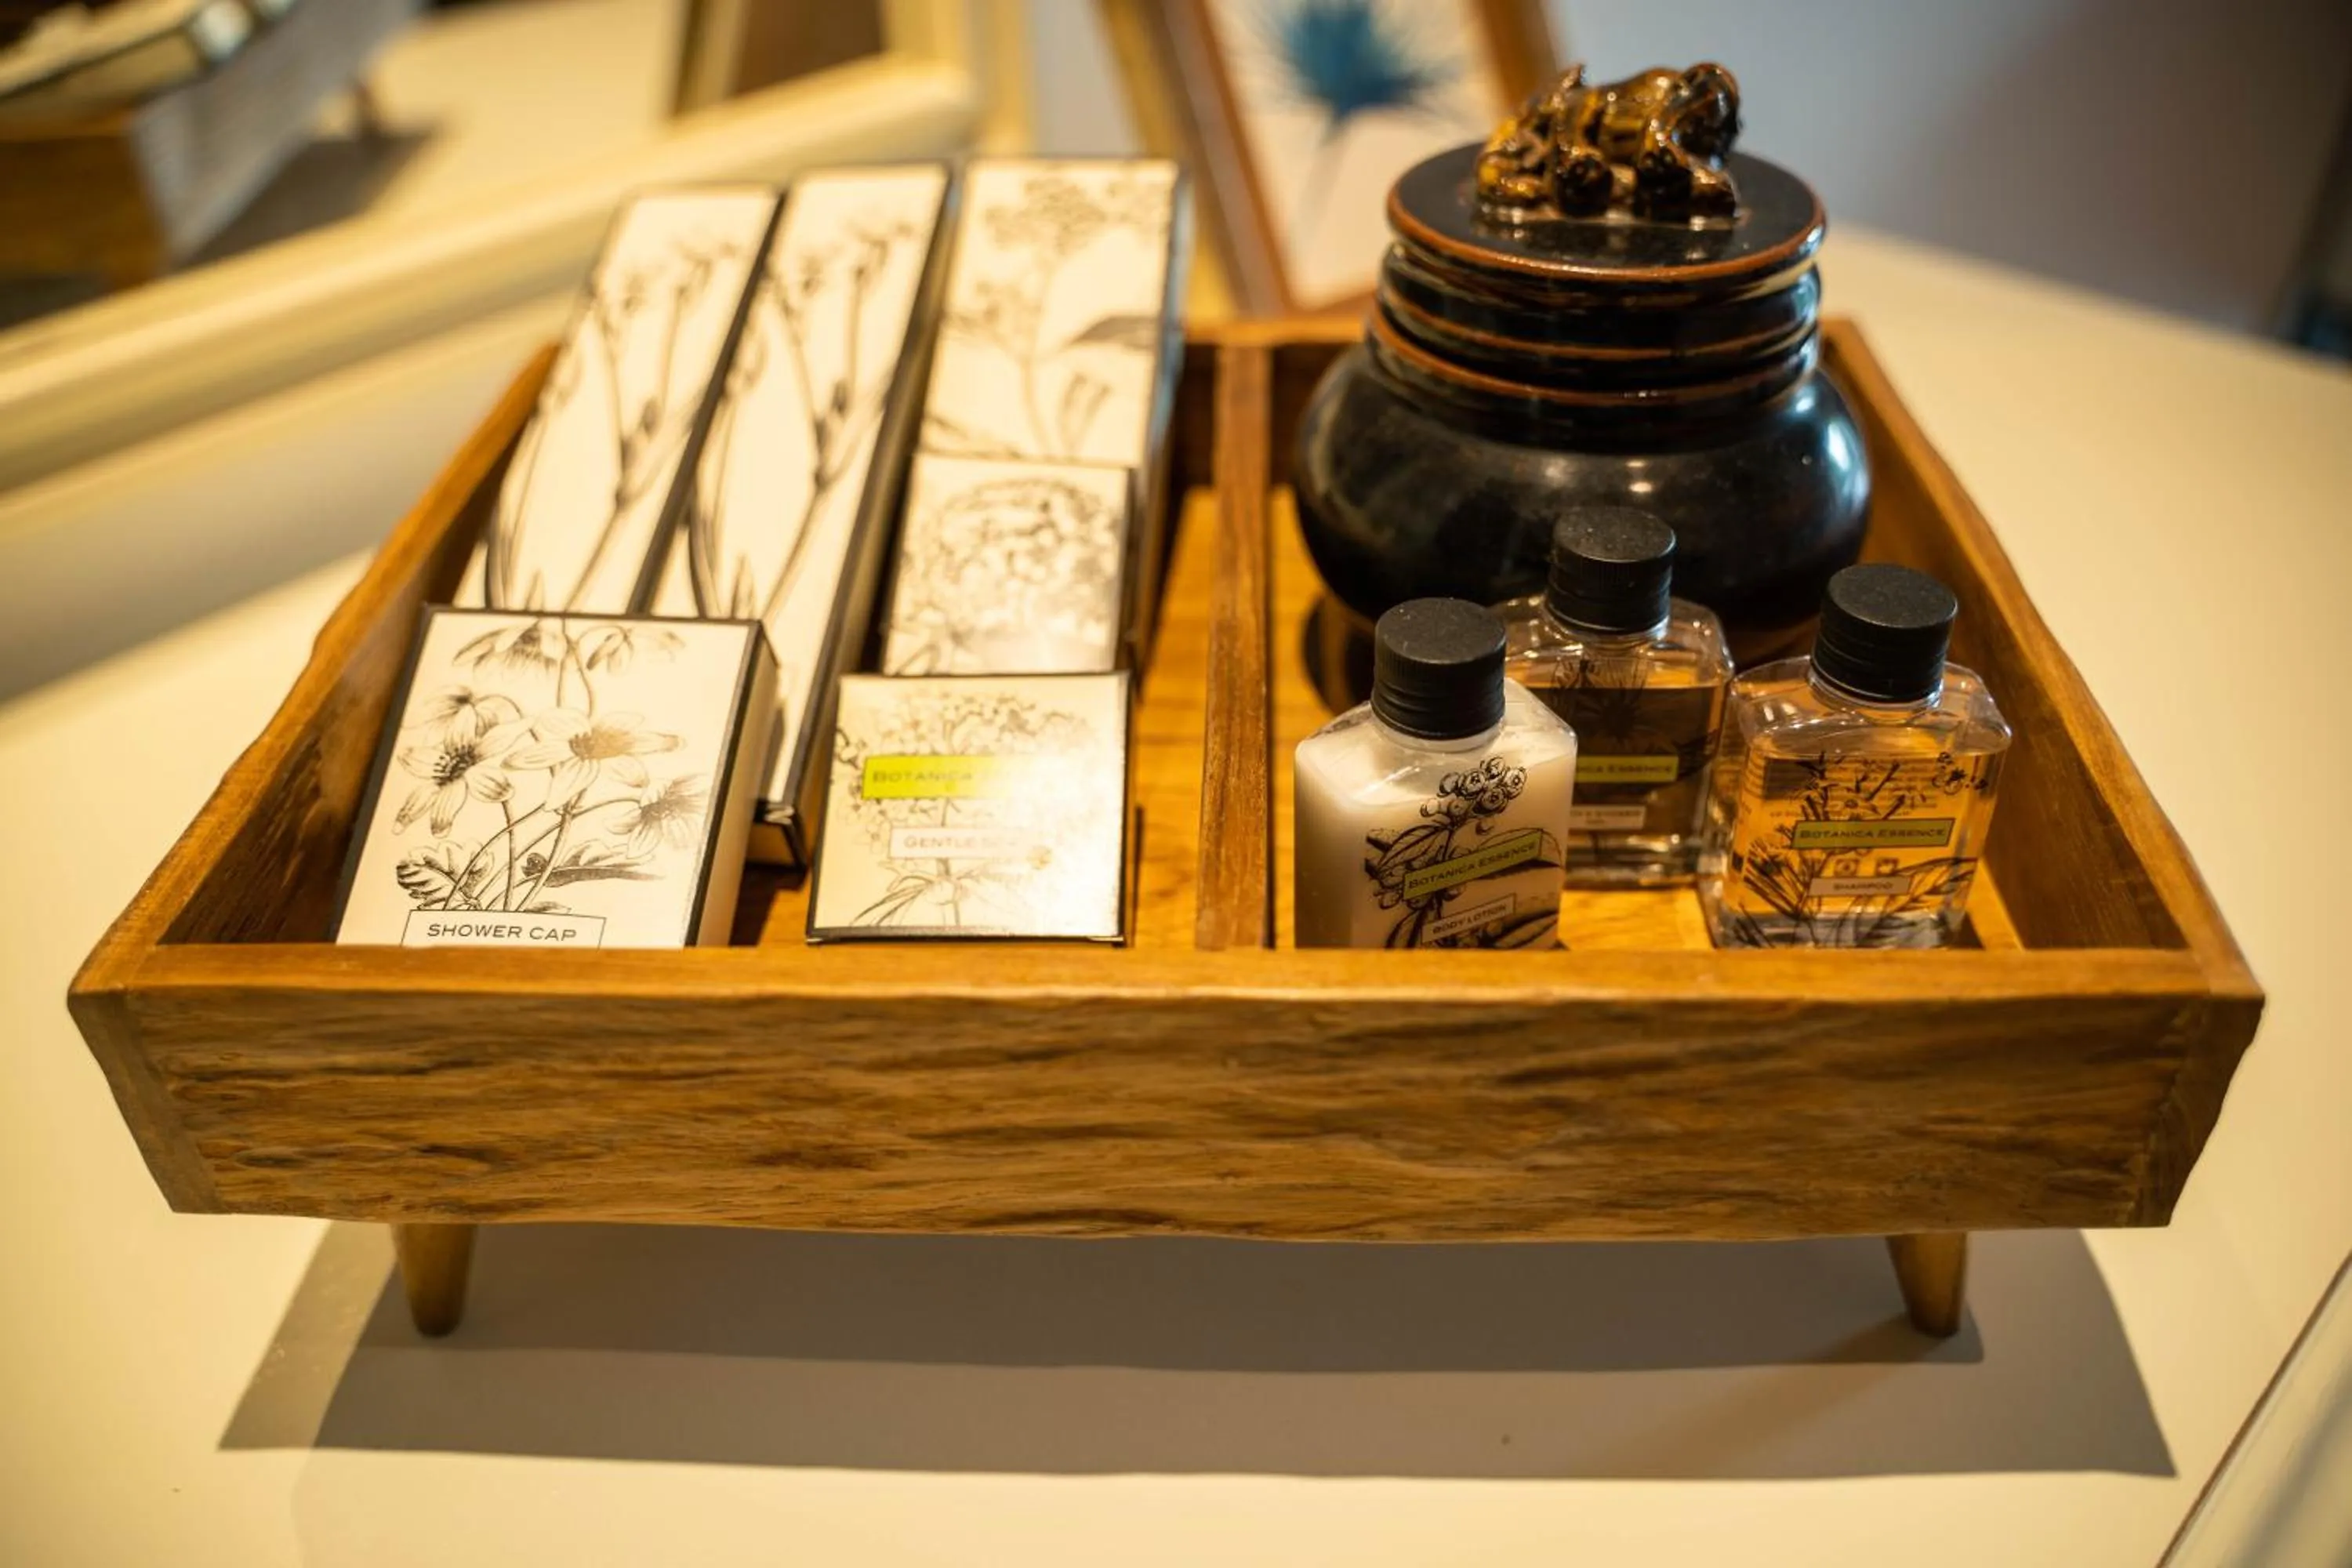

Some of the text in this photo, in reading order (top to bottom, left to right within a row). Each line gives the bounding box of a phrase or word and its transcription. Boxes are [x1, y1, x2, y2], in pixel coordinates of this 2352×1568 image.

[872, 769, 973, 783] BOTANICA
[1799, 828, 1946, 839] BOTANICA ESSENCE
[903, 835, 976, 850] GENTLE
[1408, 840, 1537, 889] BOTANICA ESSENCE
[1432, 904, 1508, 935] BODY LOTION
[426, 923, 578, 942] SHOWER CAP
